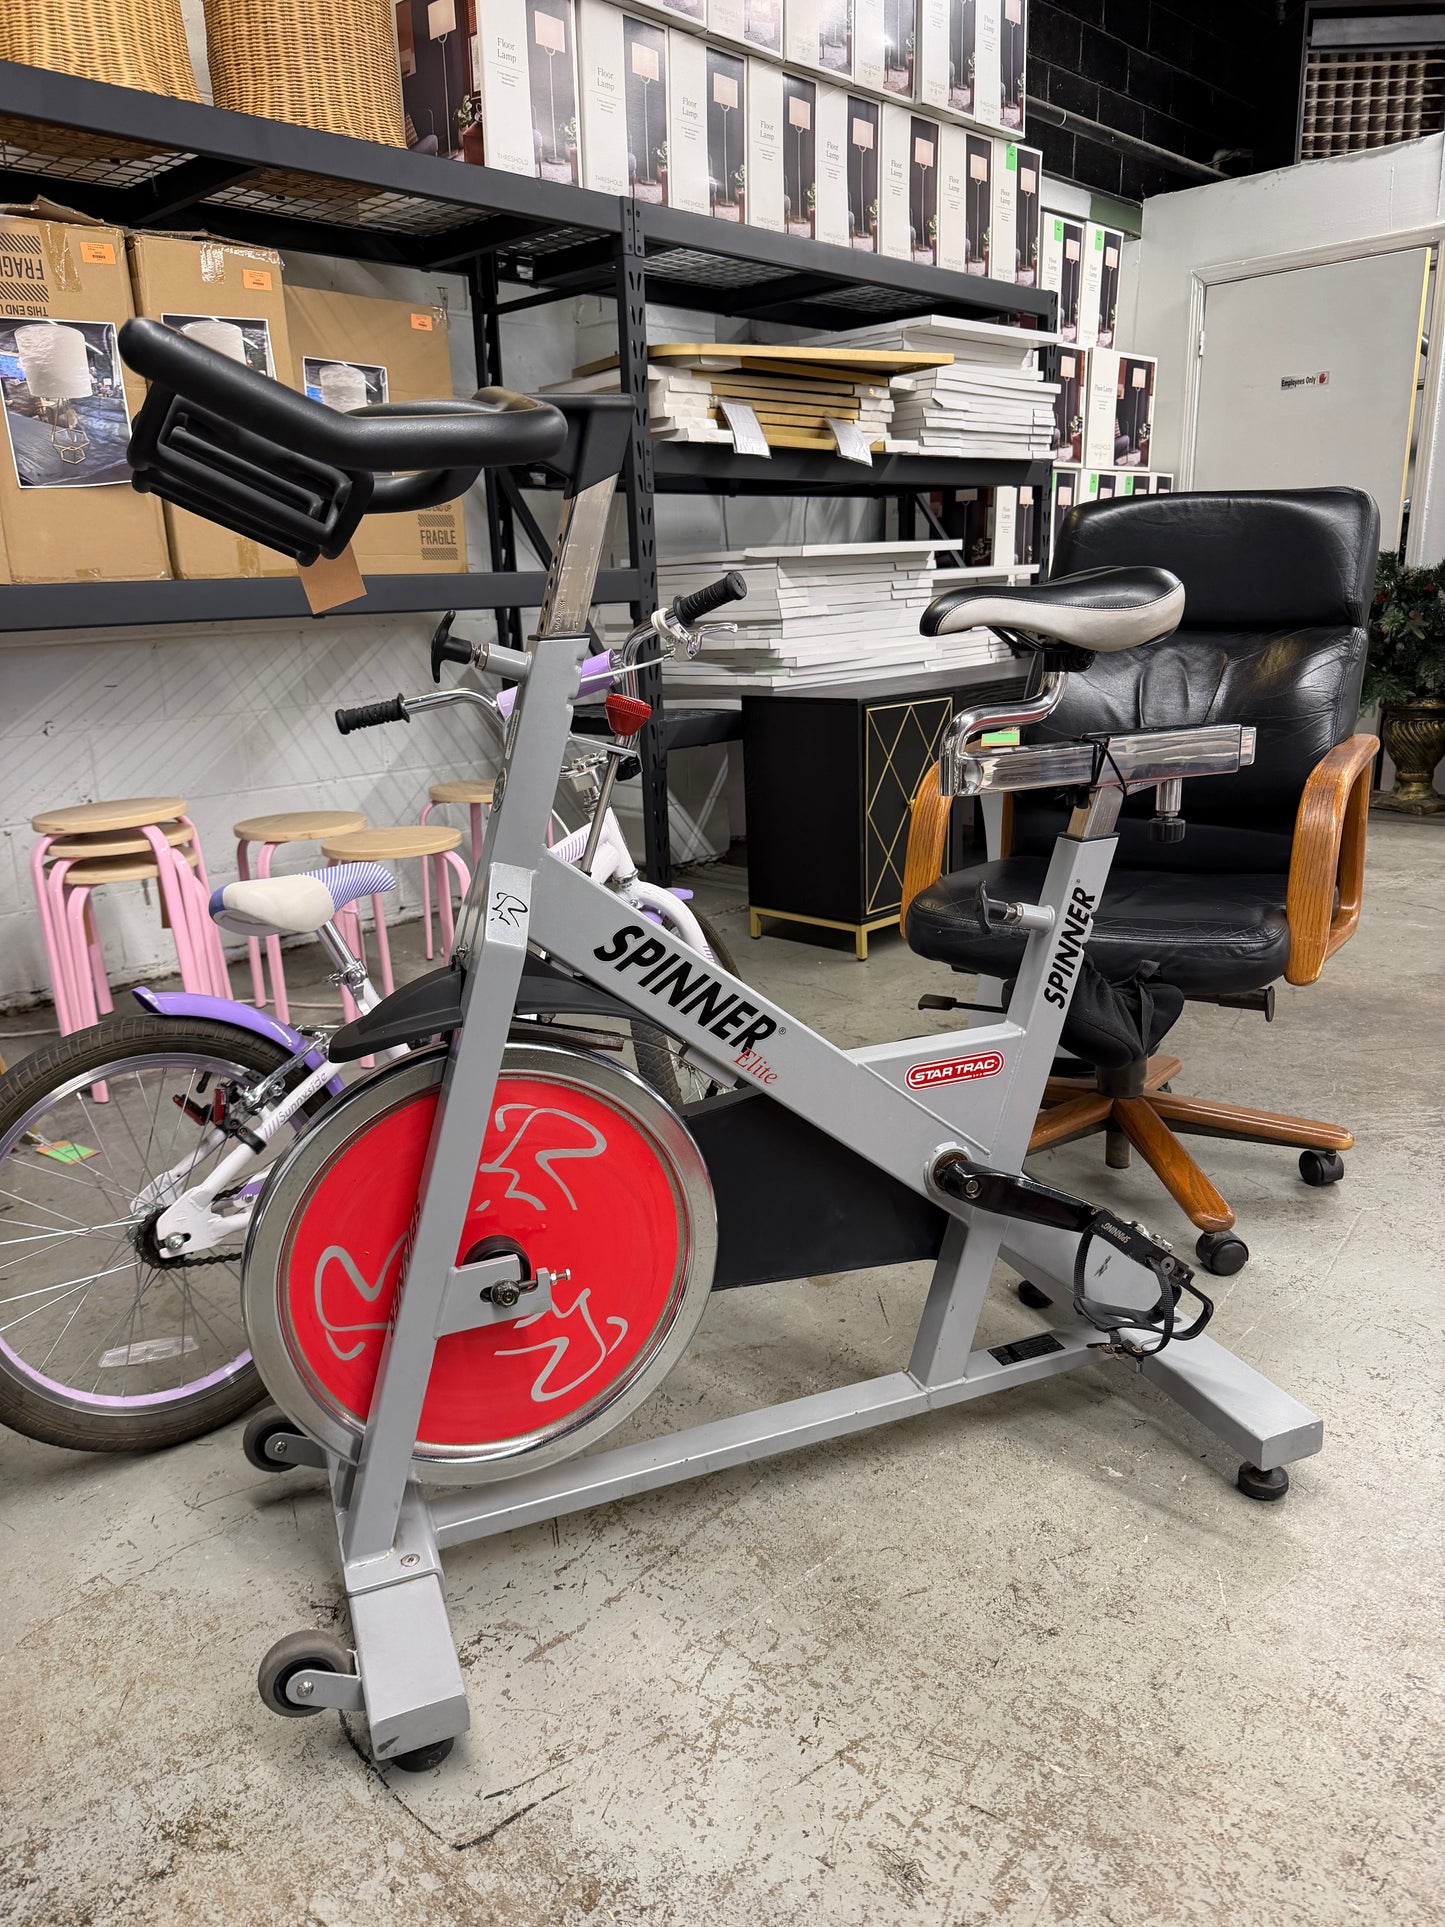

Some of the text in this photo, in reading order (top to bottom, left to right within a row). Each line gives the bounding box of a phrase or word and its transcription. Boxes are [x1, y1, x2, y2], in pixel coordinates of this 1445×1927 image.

[497, 37, 516, 50] Floor
[497, 49, 516, 64] Lamp
[597, 67, 614, 80] Floor
[597, 78, 614, 92] Lamp
[682, 96, 697, 108] Floor
[682, 107, 698, 120] Lamp
[760, 120, 774, 131] Floor
[760, 130, 775, 142] Lamp
[826, 141, 839, 151] Floor
[496, 152, 529, 166] THRESHOLD
[826, 150, 839, 160] Lamp
[890, 168, 903, 178] Lamp
[6, 304, 25, 316] END
[26, 305, 48, 317] THIS
[1281, 376, 1317, 387] Employees Only
[420, 530, 456, 545] FRAGILE
[734, 1047, 778, 1084] Elite
[915, 1059, 995, 1081] STAR TRAC
[279, 1073, 327, 1123] Sunnyside
[1104, 1222, 1131, 1243] SPINNING
